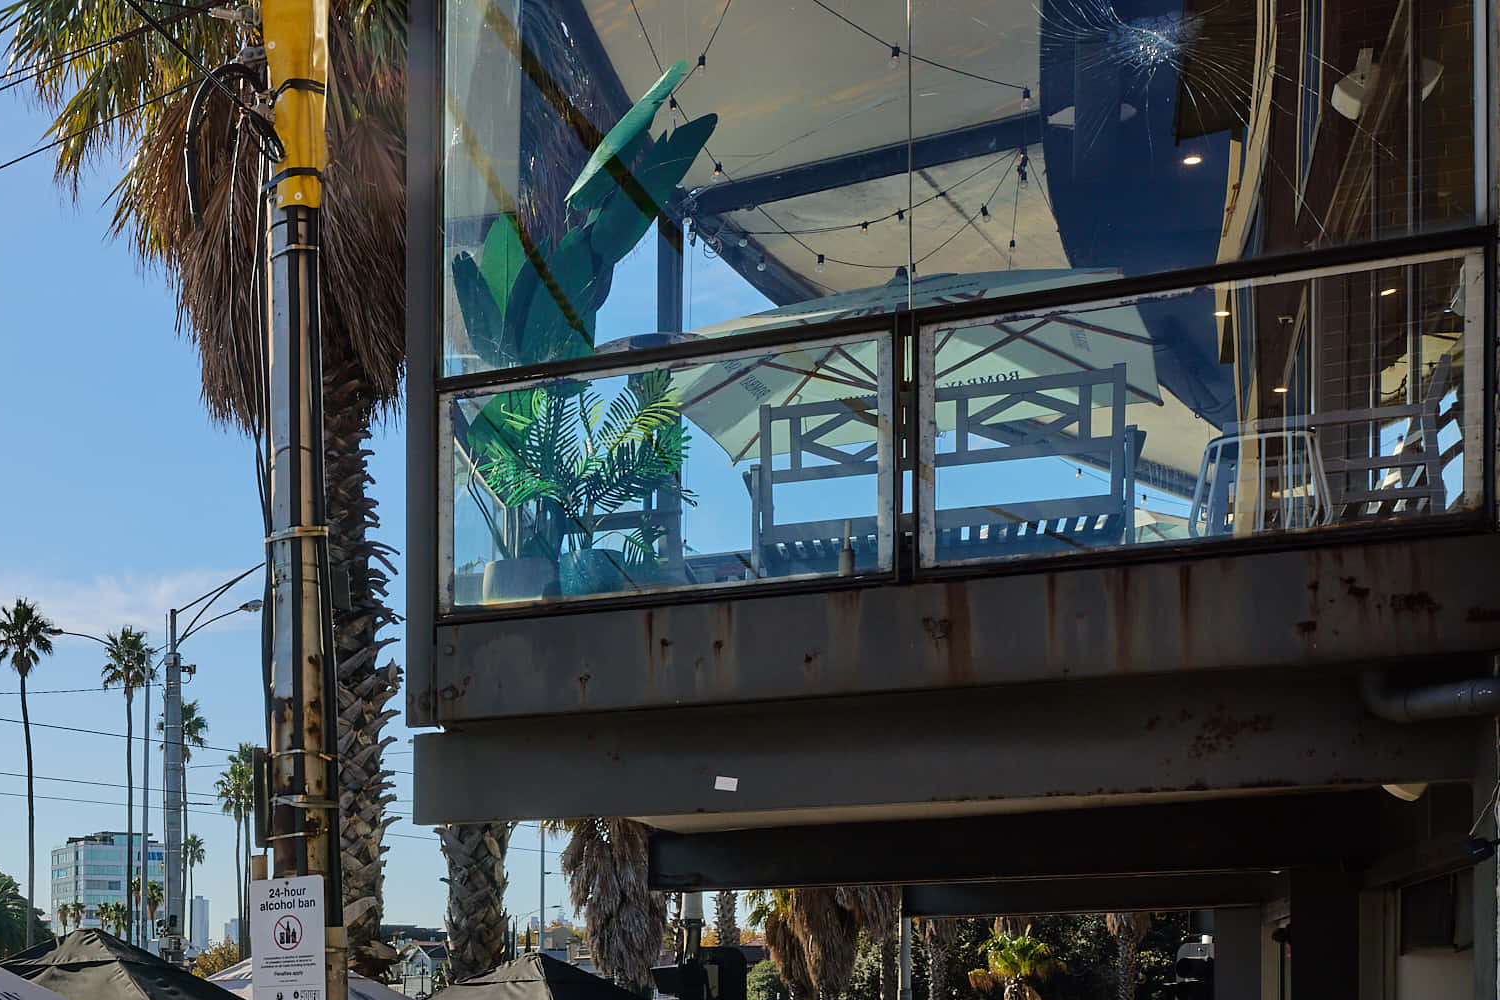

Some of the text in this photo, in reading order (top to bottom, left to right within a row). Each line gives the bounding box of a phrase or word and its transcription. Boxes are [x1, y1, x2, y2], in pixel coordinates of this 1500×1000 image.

[268, 887, 306, 899] 24-hour
[260, 898, 316, 911] alcohol ban
